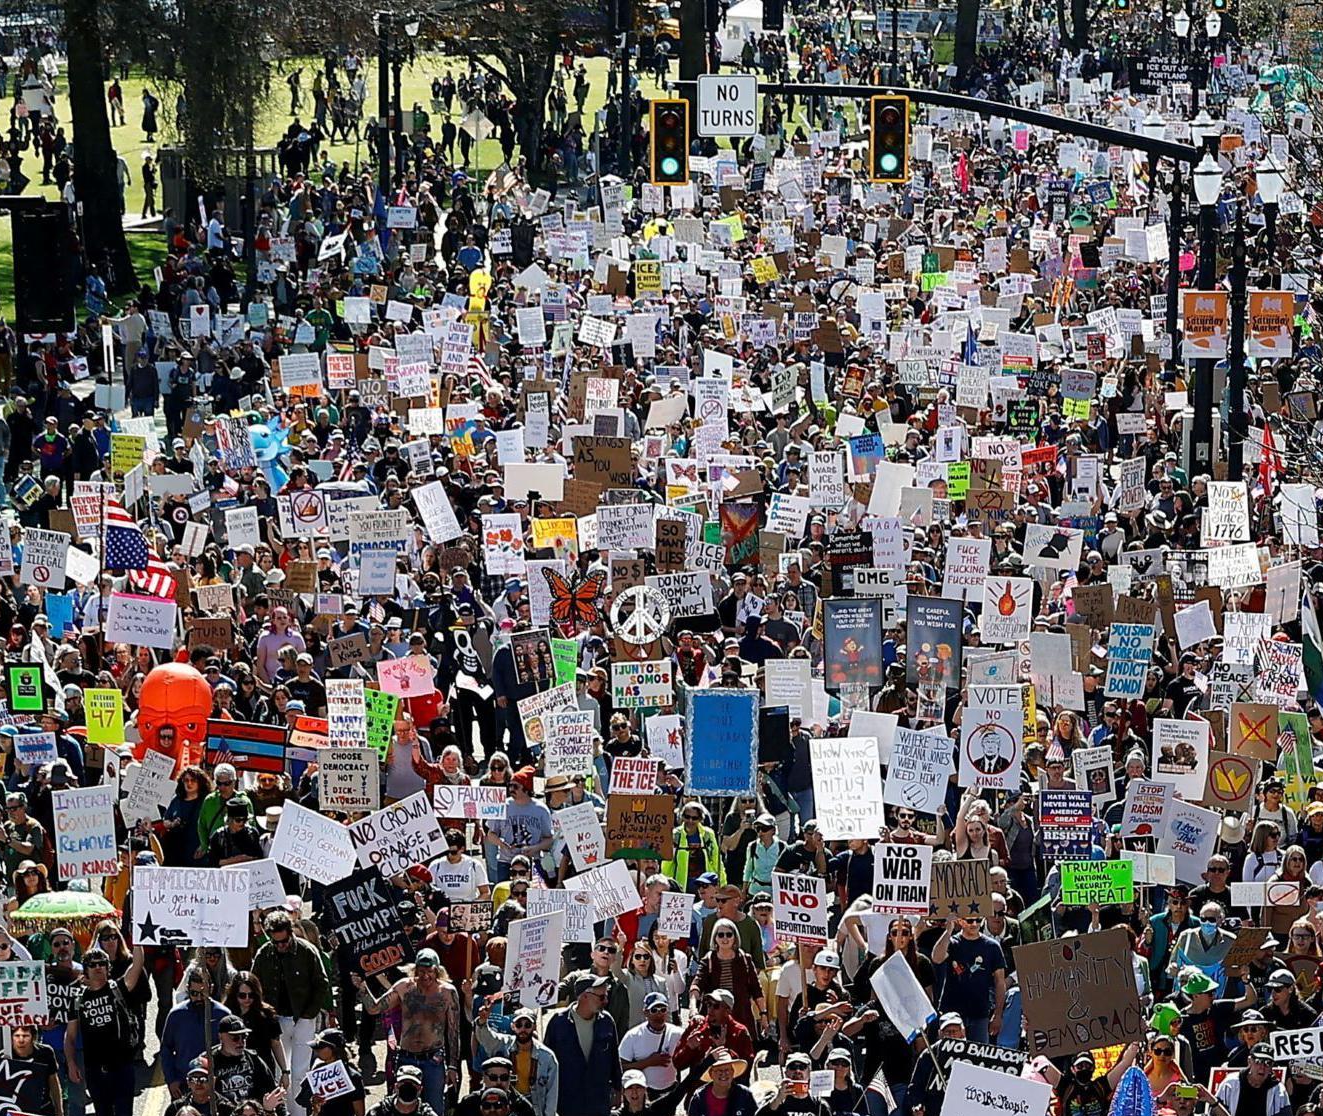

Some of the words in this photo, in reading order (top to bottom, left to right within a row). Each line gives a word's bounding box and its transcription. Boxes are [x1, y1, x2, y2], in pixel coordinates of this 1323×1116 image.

[717, 85, 739, 101] NO
[702, 110, 754, 127] TURNS
[1214, 525, 1243, 537] 1776
[957, 545, 980, 555] FUCK
[961, 554, 978, 564] THE
[949, 564, 985, 574] FUCKING
[858, 573, 889, 584] OMG
[630, 674, 669, 684] SOMOS
[618, 696, 670, 706] FUERTES!
[975, 689, 1018, 704] VOTE
[986, 710, 1001, 720] NO
[332, 752, 363, 760] CHOOSE
[614, 760, 657, 772] REVOKE
[339, 774, 353, 782] NOT
[613, 773, 633, 788] THE
[635, 774, 656, 790] ICE
[976, 777, 1004, 787] KINGS
[1049, 808, 1083, 816] AMERICA
[1044, 830, 1088, 841] RESIST!
[886, 846, 917, 858] NO
[884, 859, 921, 880] WAR
[1066, 862, 1107, 873] TRUMP
[1074, 873, 1112, 881] NATIONAL
[779, 878, 795, 890] WE
[797, 880, 818, 893] SAY
[1075, 880, 1113, 889] SECURITY
[877, 885, 894, 901] ON
[898, 886, 926, 902] IRAN
[1066, 888, 1127, 903] THREAT
[780, 892, 818, 908] NO
[790, 911, 810, 922] TO
[777, 921, 826, 937] DEPORTATIONS
